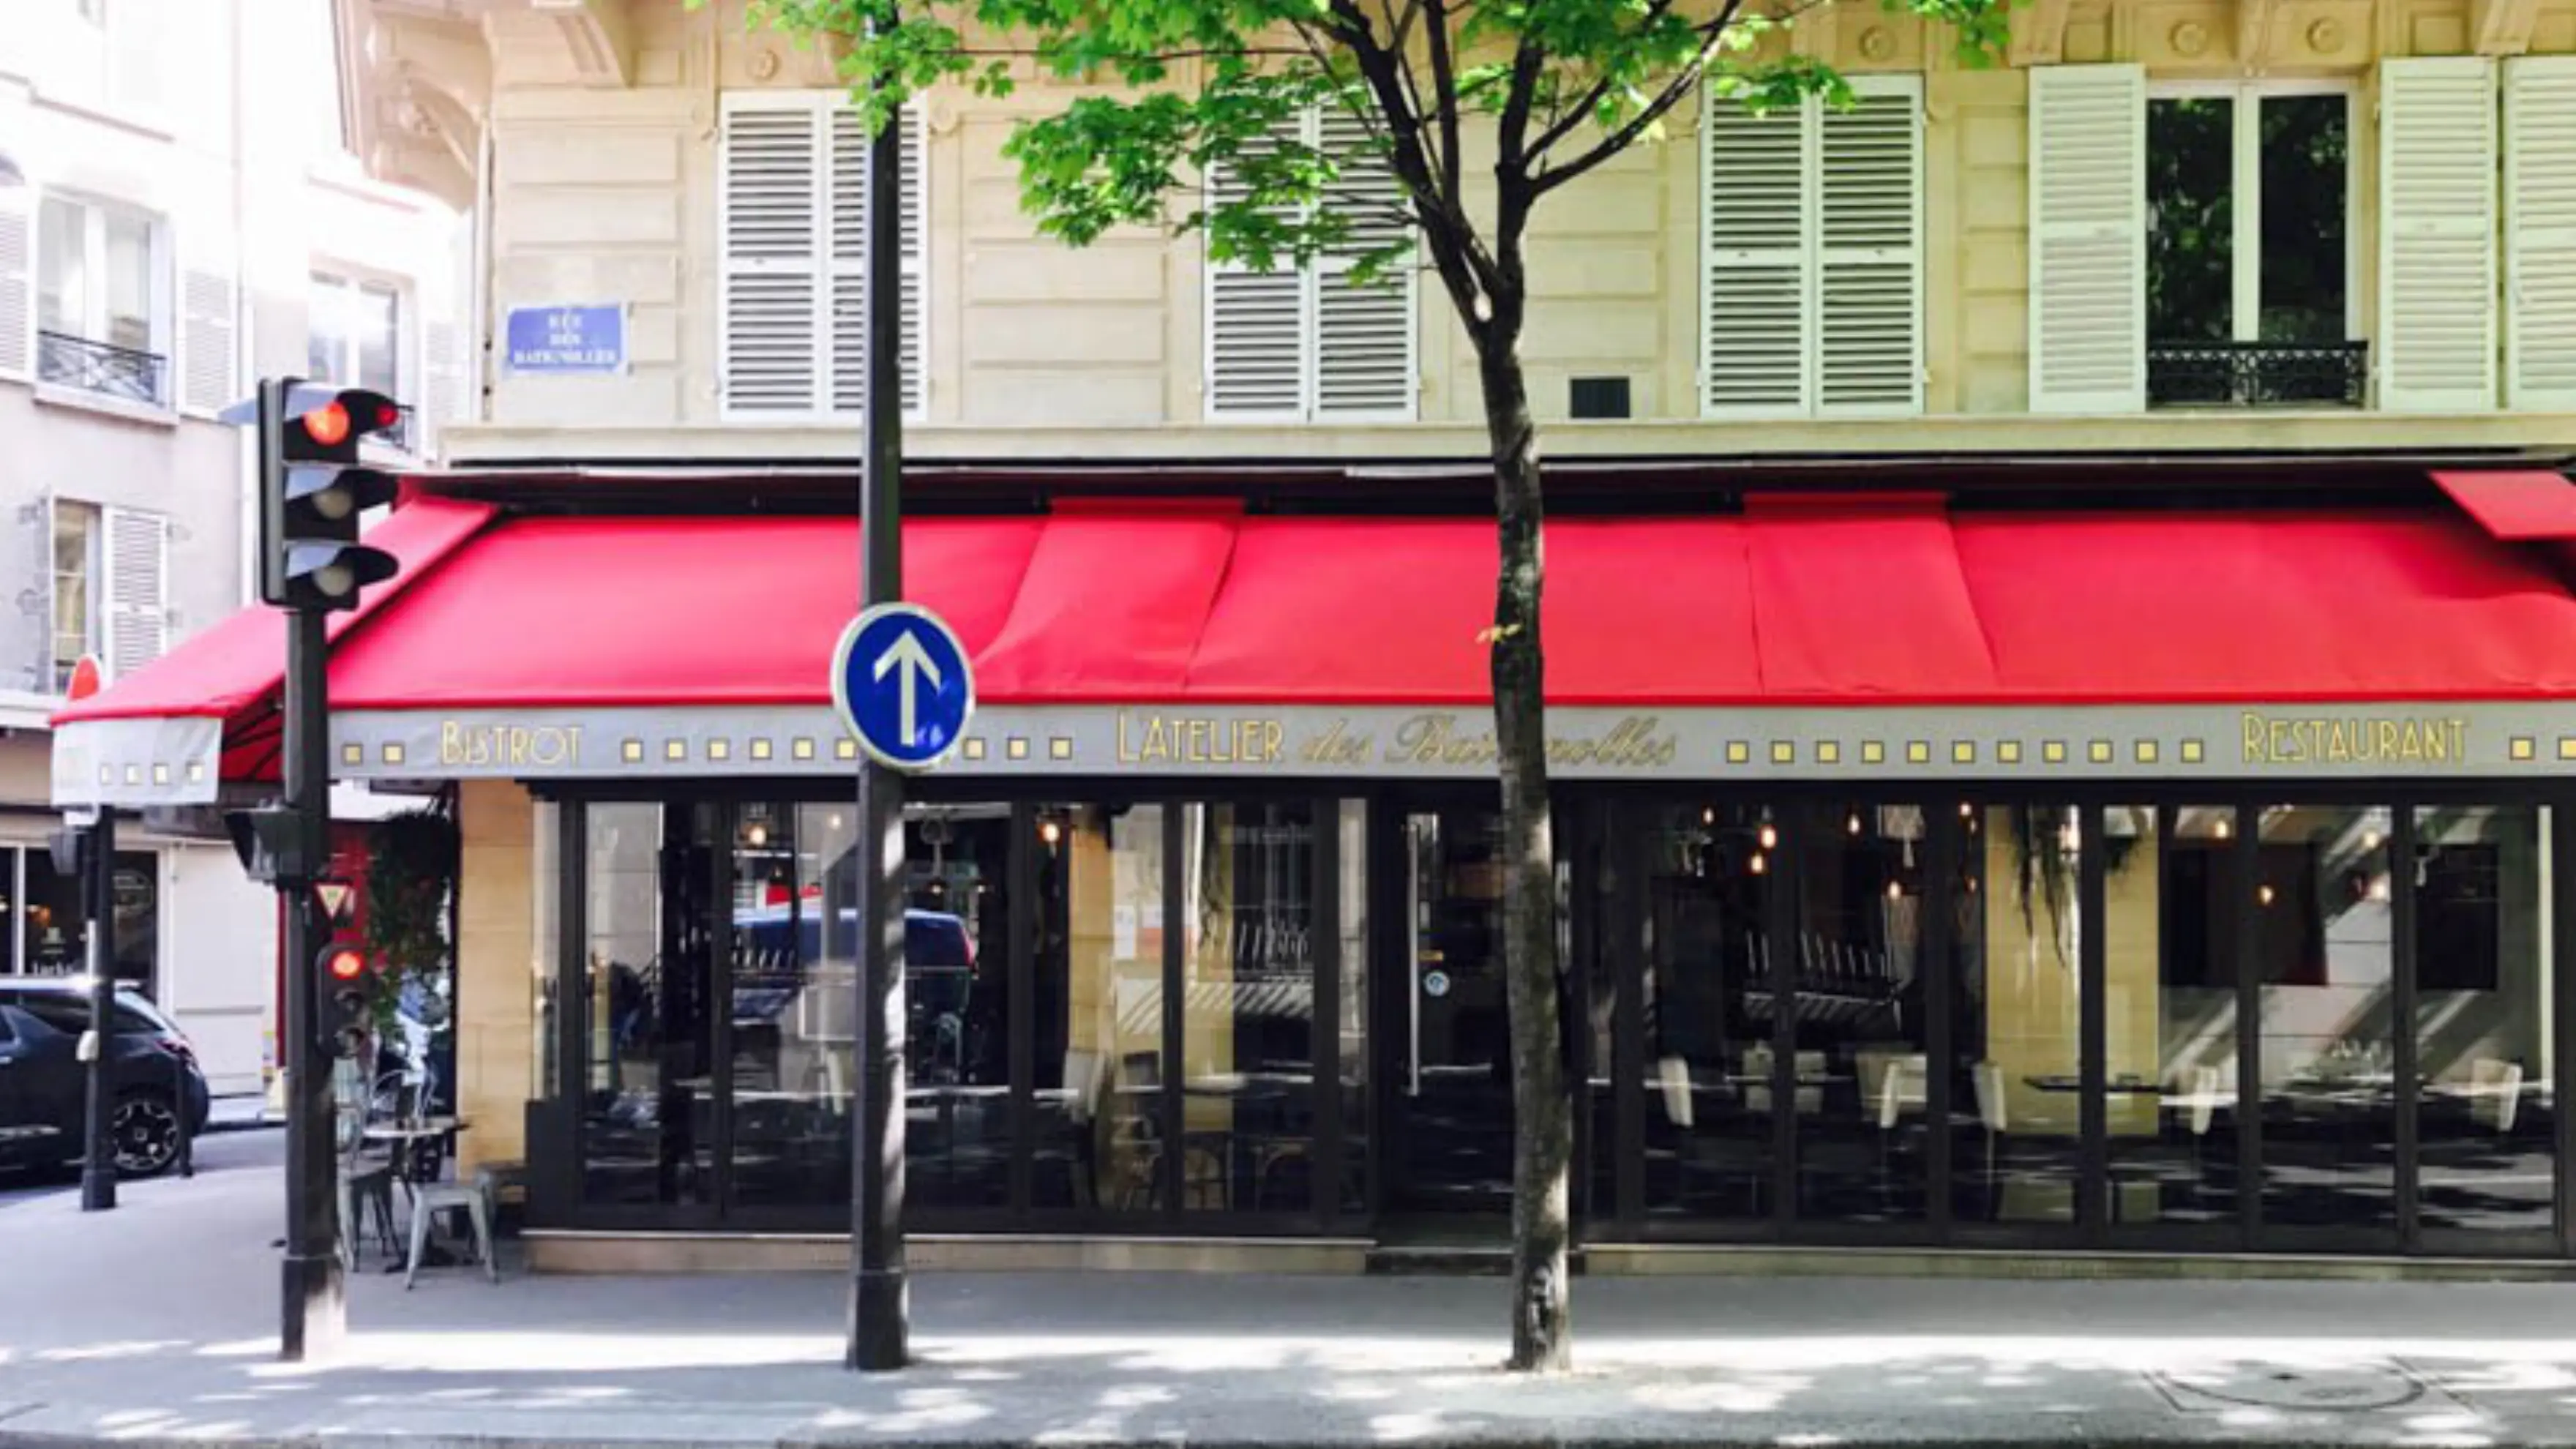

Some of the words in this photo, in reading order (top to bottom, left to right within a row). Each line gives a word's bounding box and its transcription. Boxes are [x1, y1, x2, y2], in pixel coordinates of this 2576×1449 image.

[442, 720, 585, 765] BISTROT
[1299, 716, 1374, 764] des
[2242, 711, 2471, 763] RESTAURANT
